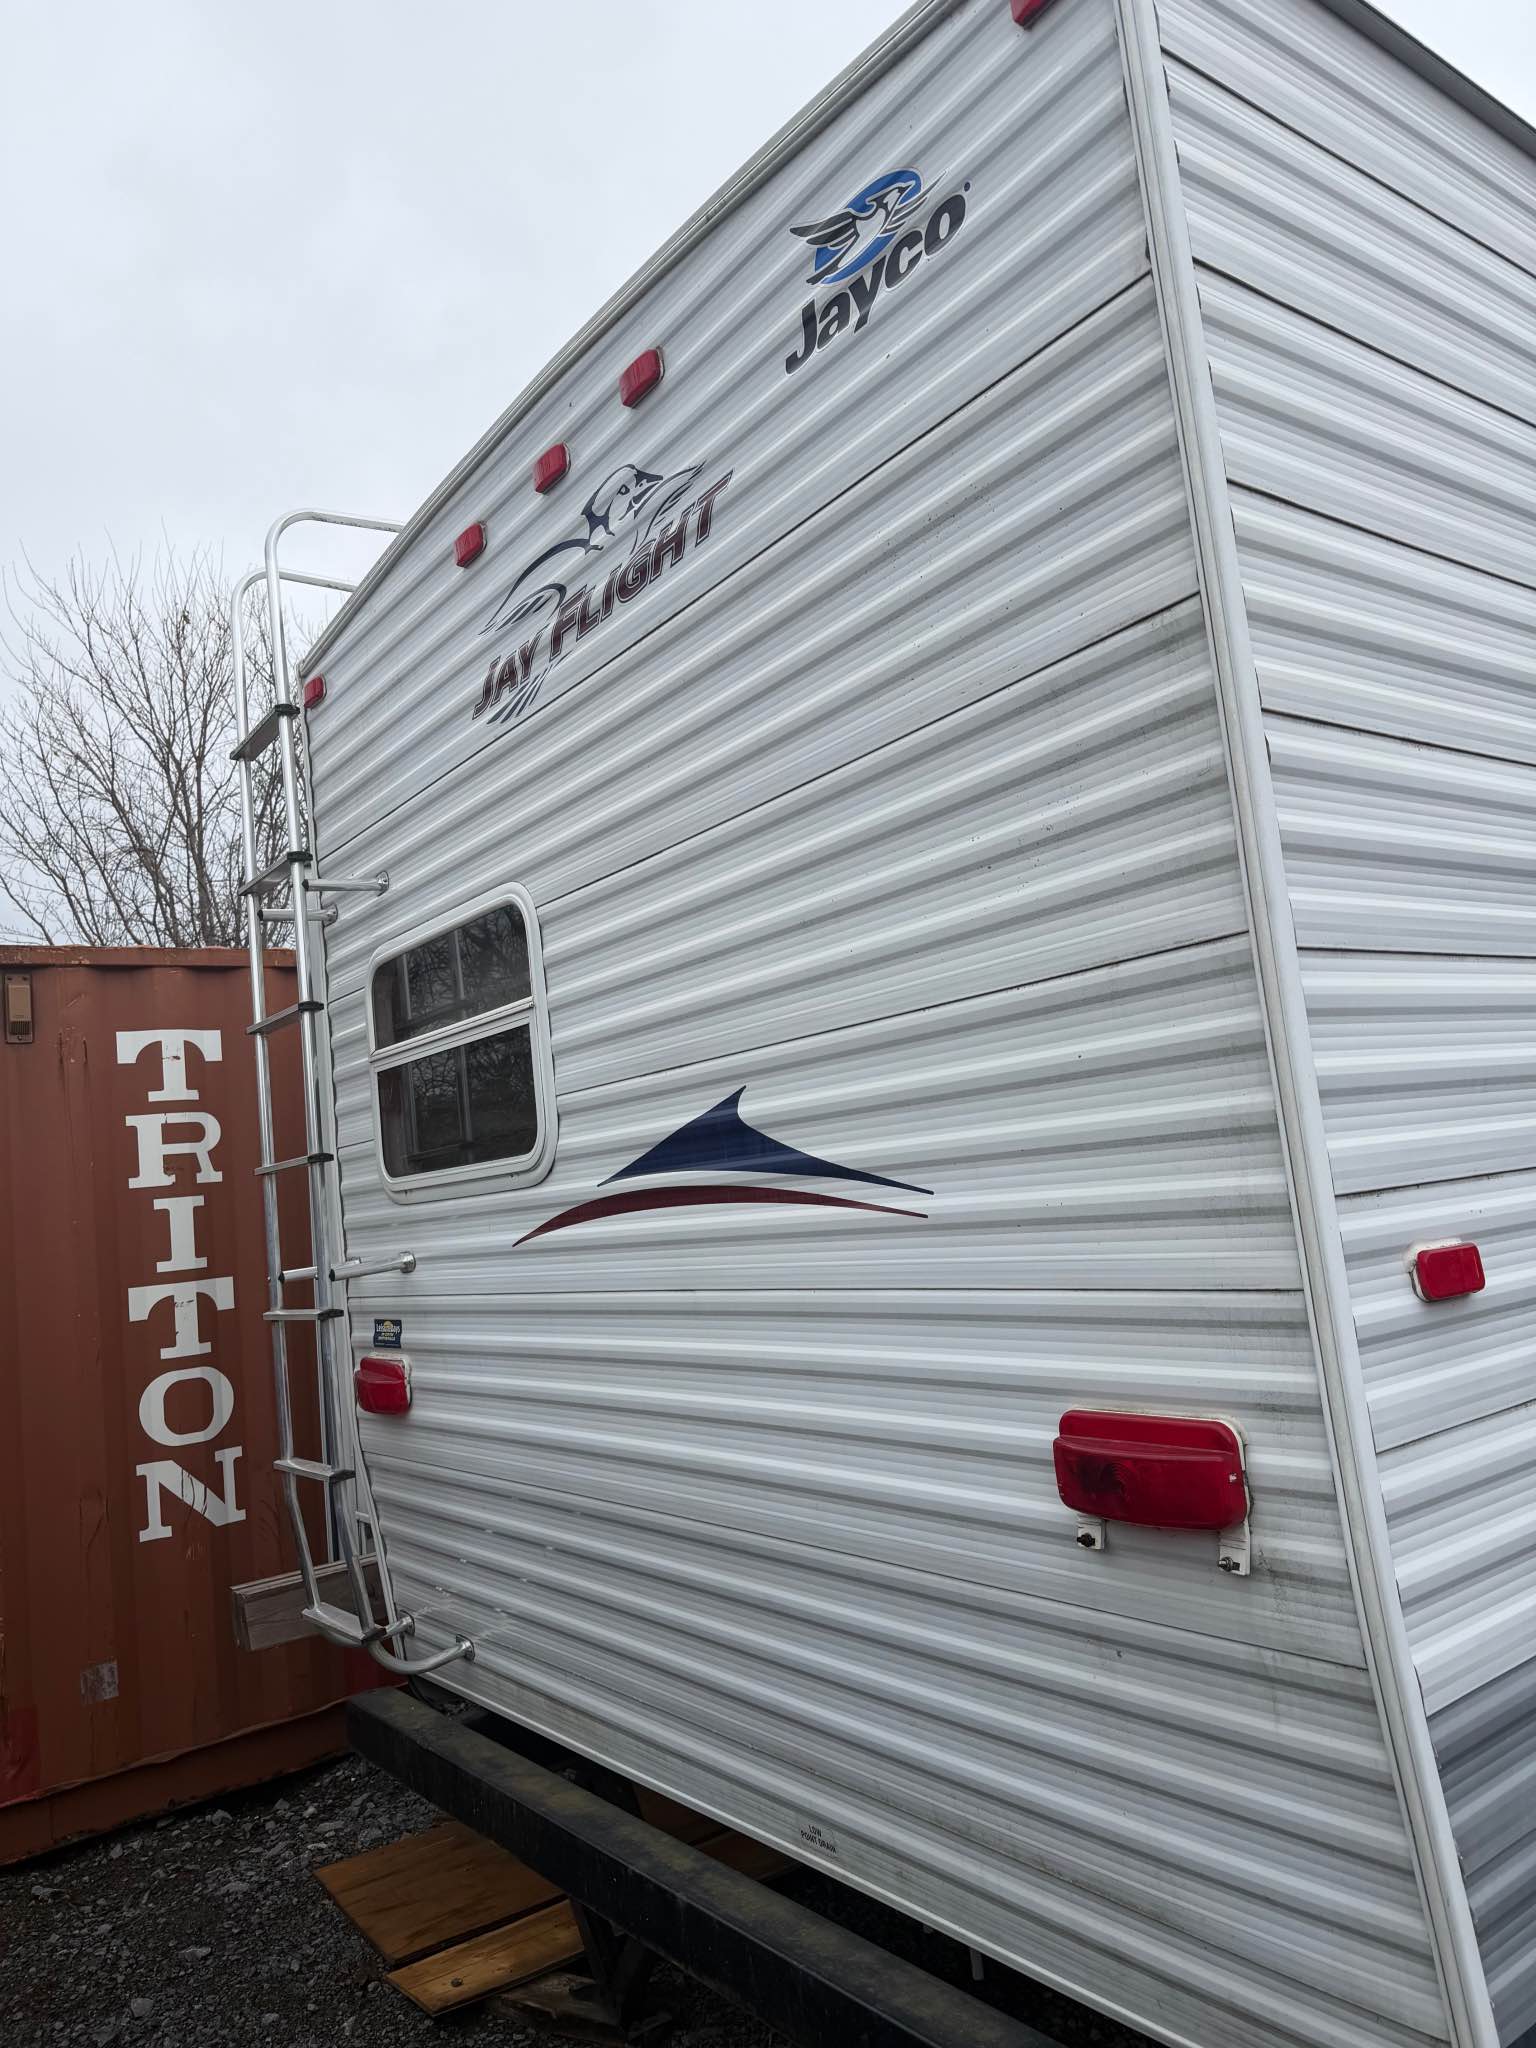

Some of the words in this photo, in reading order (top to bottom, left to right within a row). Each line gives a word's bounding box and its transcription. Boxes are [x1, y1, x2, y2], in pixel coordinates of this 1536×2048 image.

[472, 622, 550, 720] JAY
[549, 468, 733, 663] FLIGHT
[116, 1029, 246, 1542] TRITON
